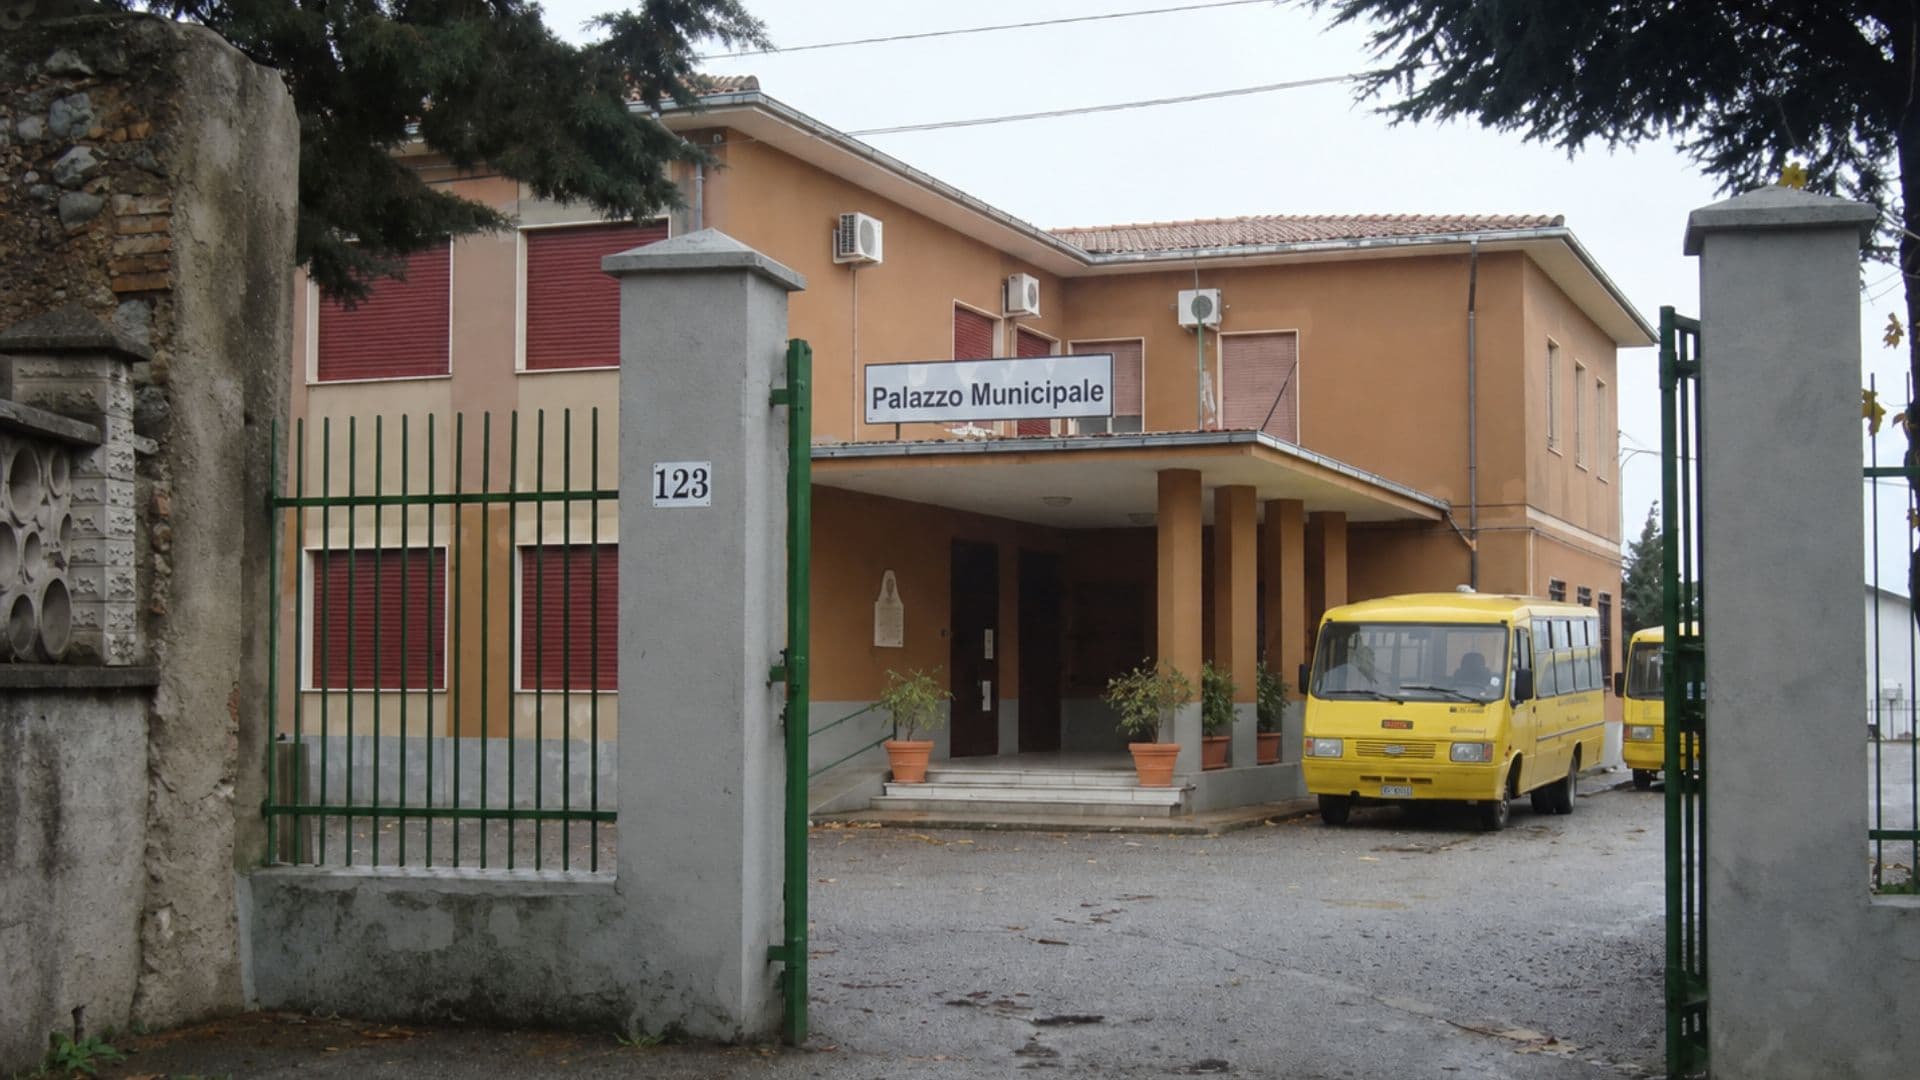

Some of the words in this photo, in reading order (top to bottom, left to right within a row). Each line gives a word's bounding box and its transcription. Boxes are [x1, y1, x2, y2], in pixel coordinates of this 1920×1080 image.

[873, 386, 963, 410] Palazzo
[971, 378, 1104, 409] Municipale
[655, 468, 708, 499] 123
